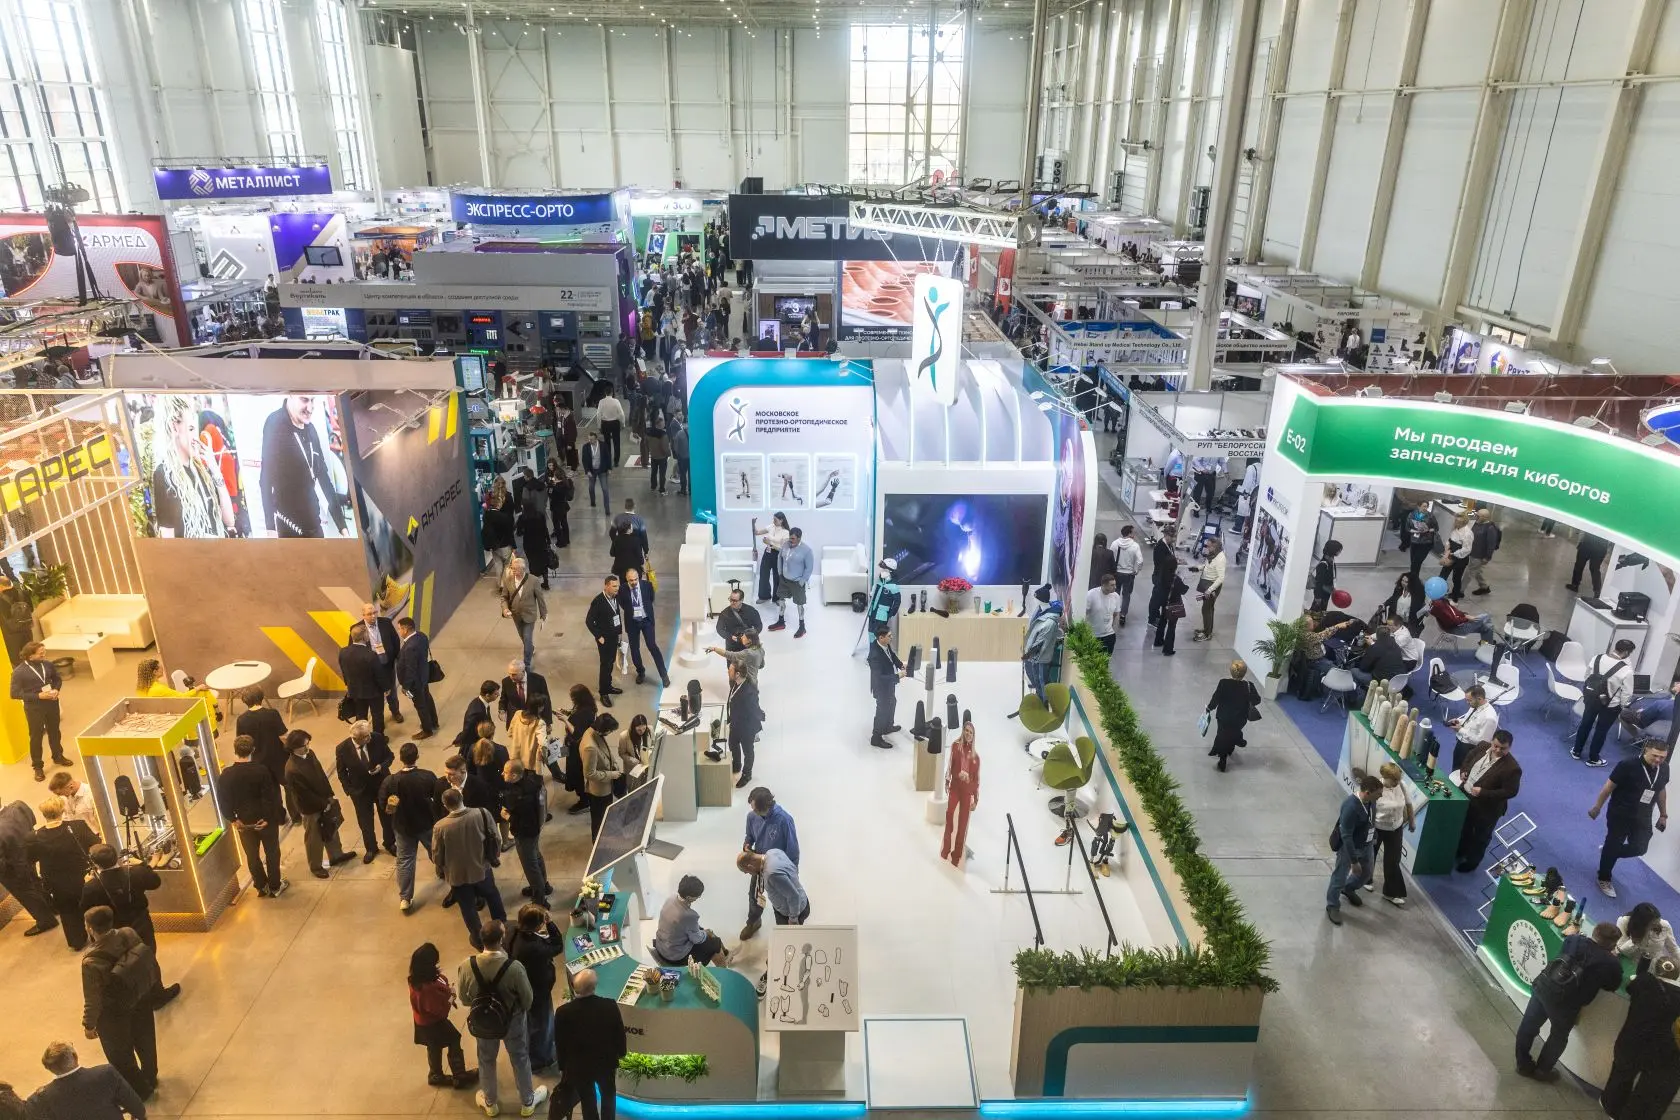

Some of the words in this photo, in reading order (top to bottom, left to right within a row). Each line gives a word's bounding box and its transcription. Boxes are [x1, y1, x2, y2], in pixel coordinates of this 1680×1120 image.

[215, 175, 300, 190] МЕТАЛЛИСТ
[466, 202, 574, 218] ЭКСПРЕСС-ОРТО
[92, 235, 147, 248] АРМЕД
[560, 290, 573, 300] 22
[1394, 427, 1425, 442] Мы
[1430, 432, 1519, 457] продаем
[1389, 447, 1477, 470] запчасти
[1481, 459, 1519, 478] для
[1524, 469, 1612, 504] киборгов
[421, 479, 462, 531] АНТАРЕС
[624, 1026, 644, 1035] КОЕ
